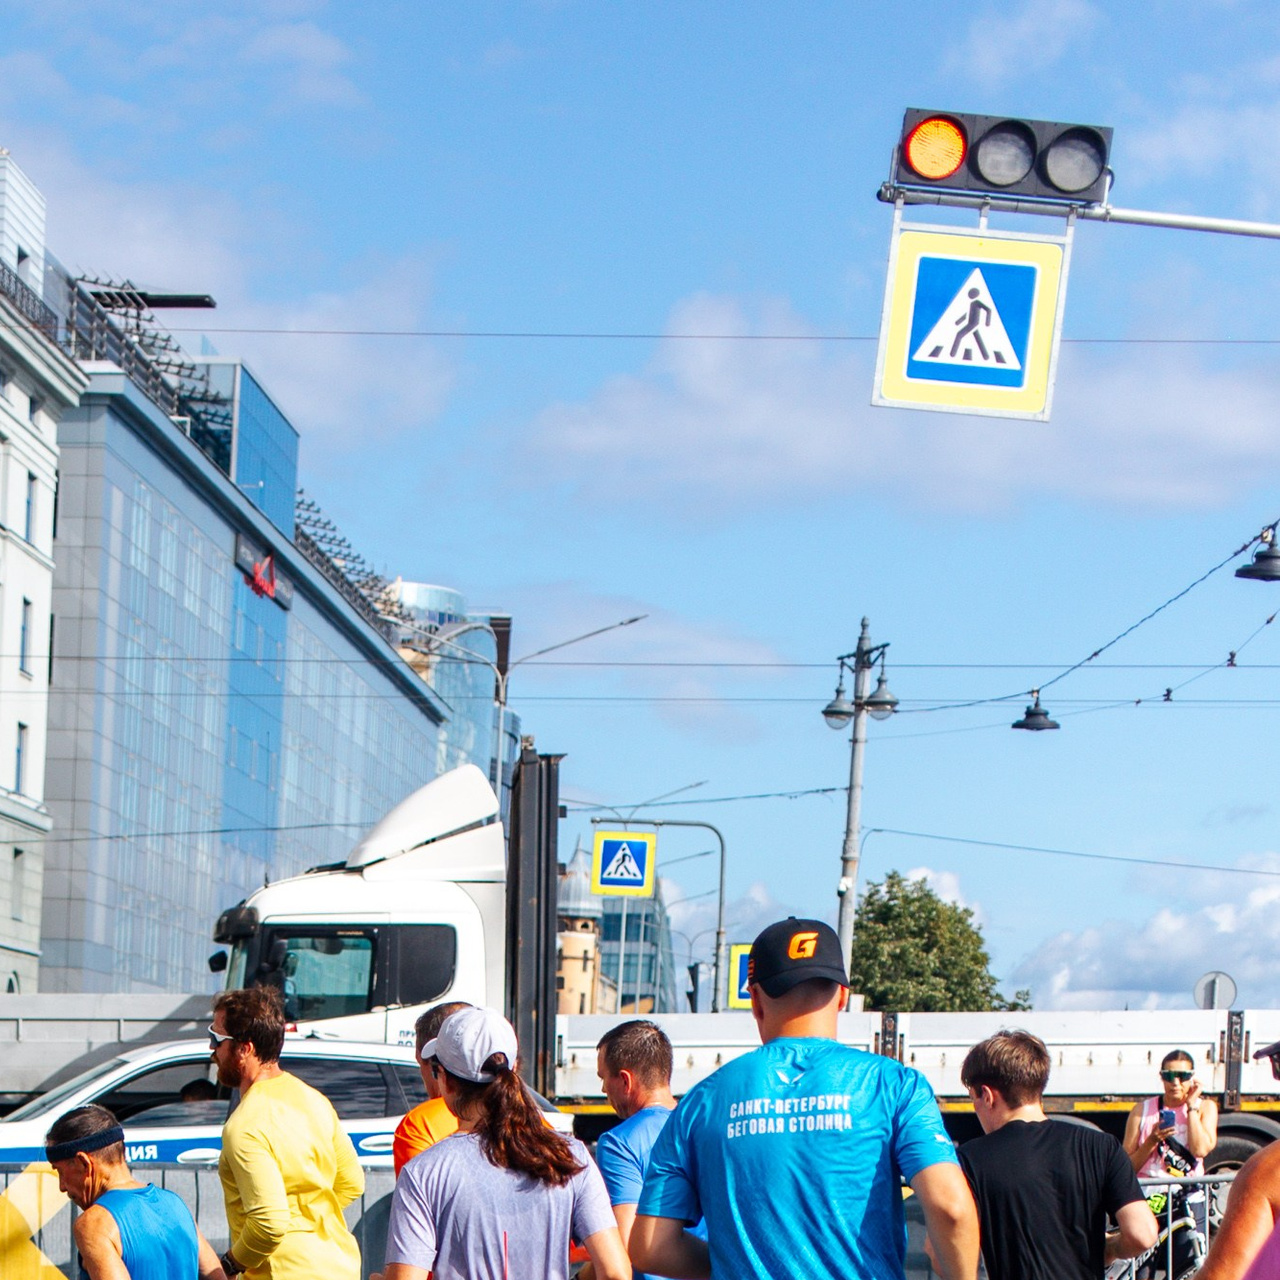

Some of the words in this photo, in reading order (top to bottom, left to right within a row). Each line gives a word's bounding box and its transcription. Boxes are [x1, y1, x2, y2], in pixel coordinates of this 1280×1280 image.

[729, 1094, 852, 1119] САНКТ-ПЕТЕРБУРГ
[726, 1117, 785, 1139] БЕГОВАЯ
[788, 1113, 853, 1132] СТОЛИЦА
